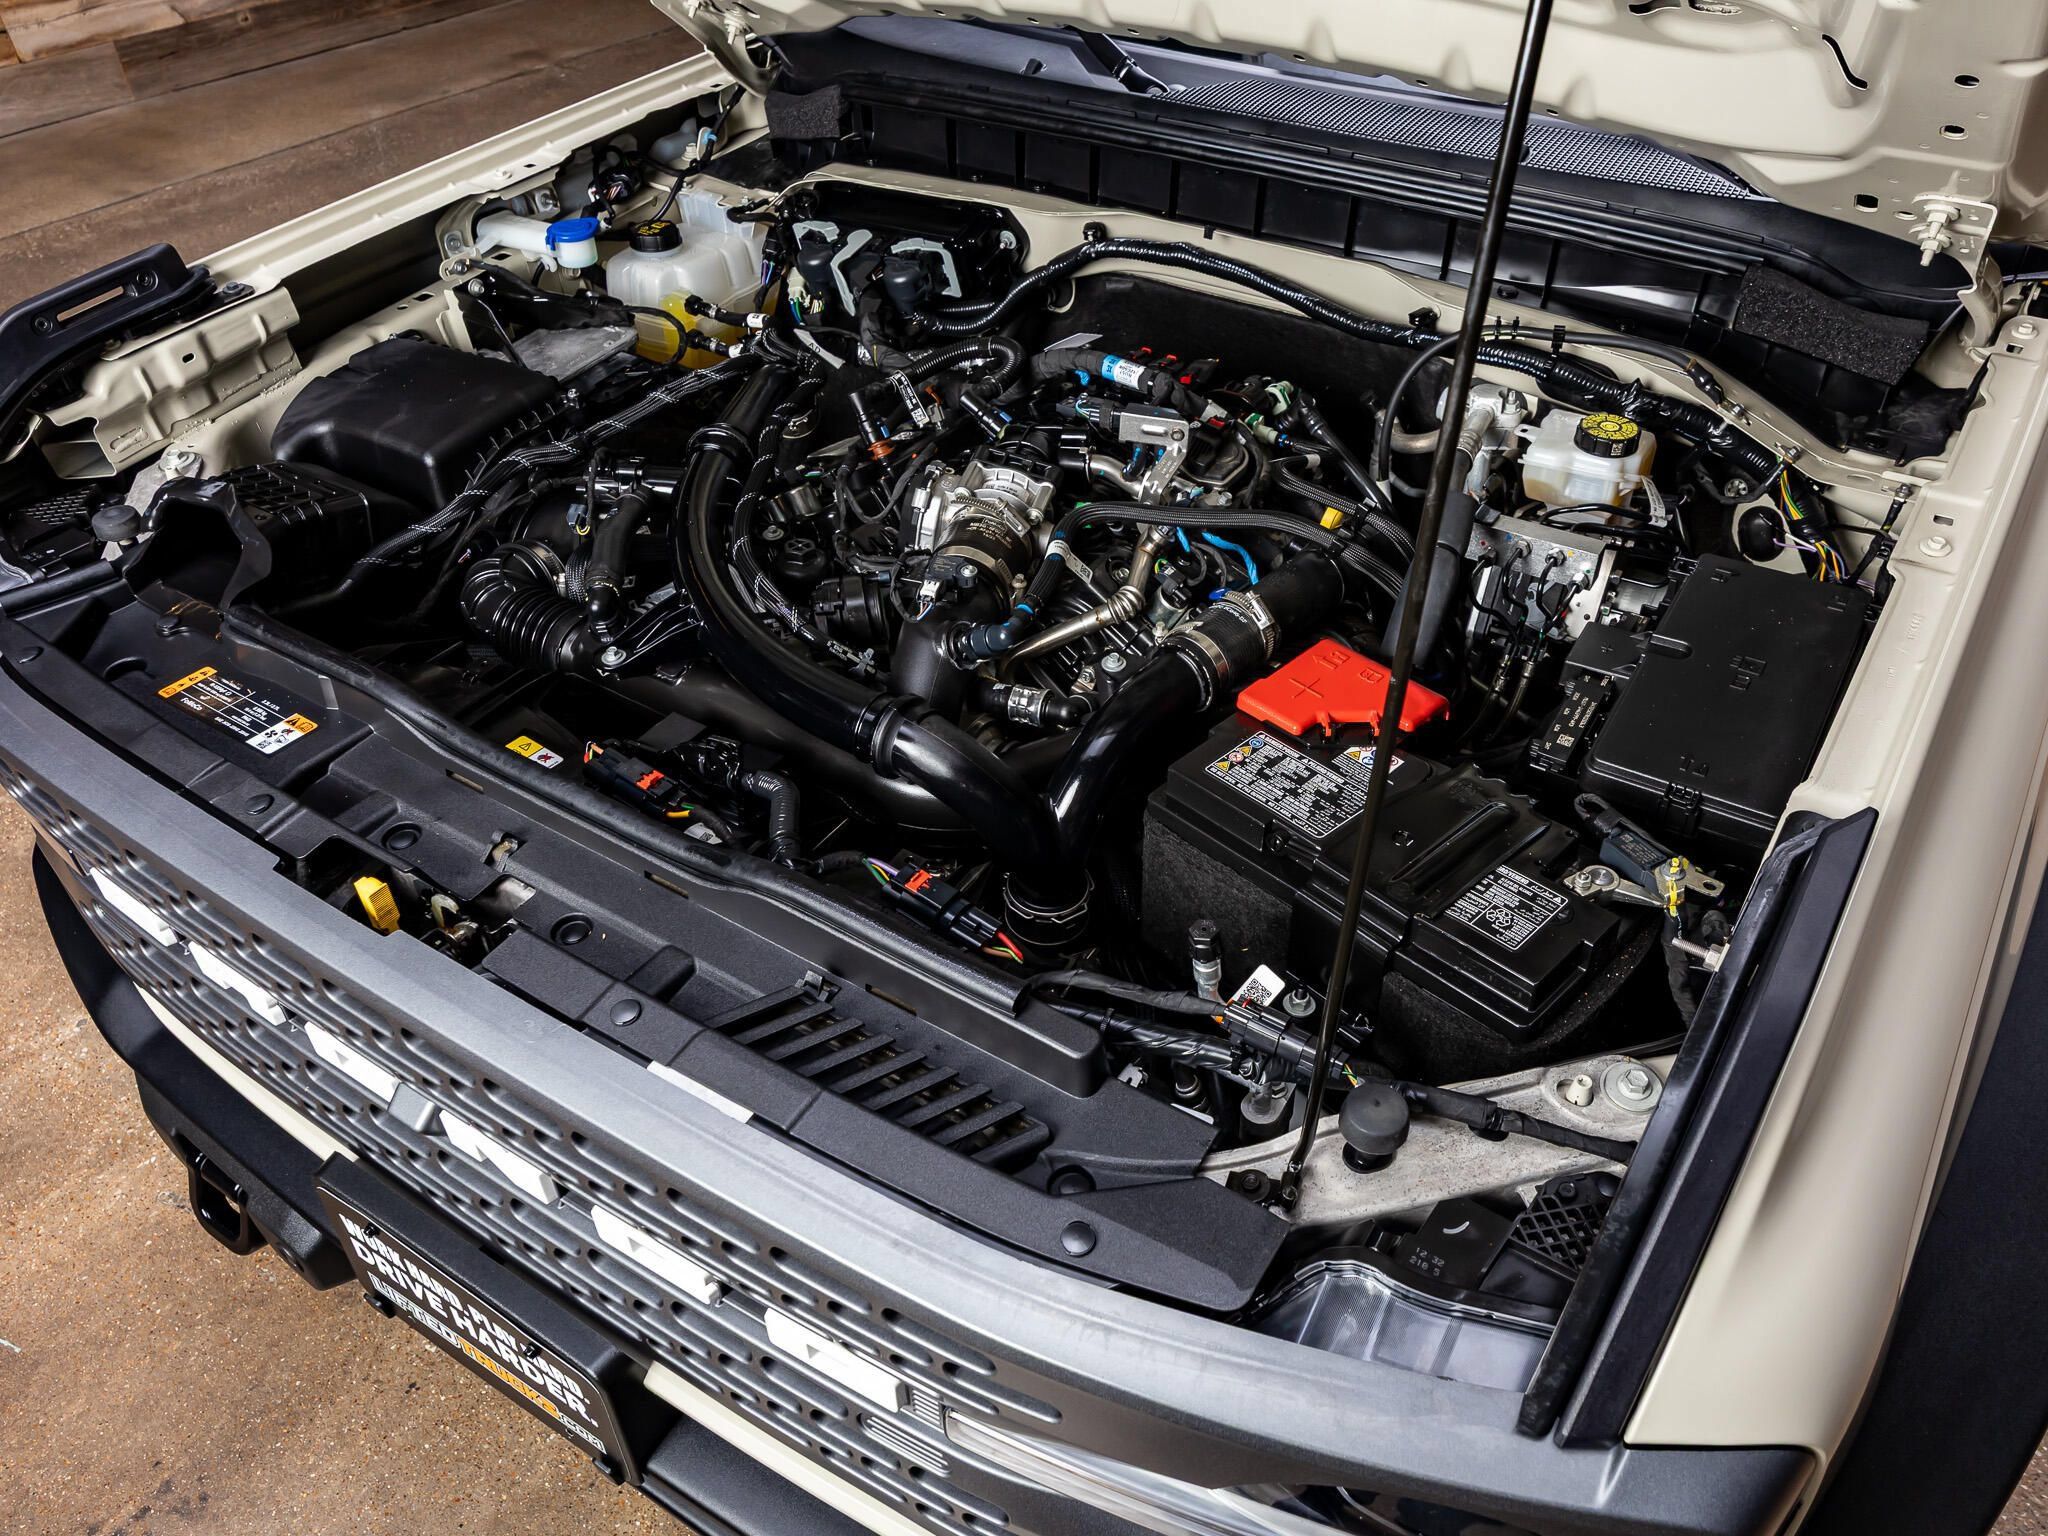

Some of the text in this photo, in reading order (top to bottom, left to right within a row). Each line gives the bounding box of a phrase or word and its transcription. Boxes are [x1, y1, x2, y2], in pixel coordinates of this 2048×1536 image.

[339, 1213, 406, 1272] WORK
[404, 1258, 469, 1316] HARD.
[467, 1304, 518, 1352] PLAY
[350, 1236, 598, 1428] DRIVE HARDER.
[367, 1270, 607, 1454] LIFTEDTRUCKS.COM
